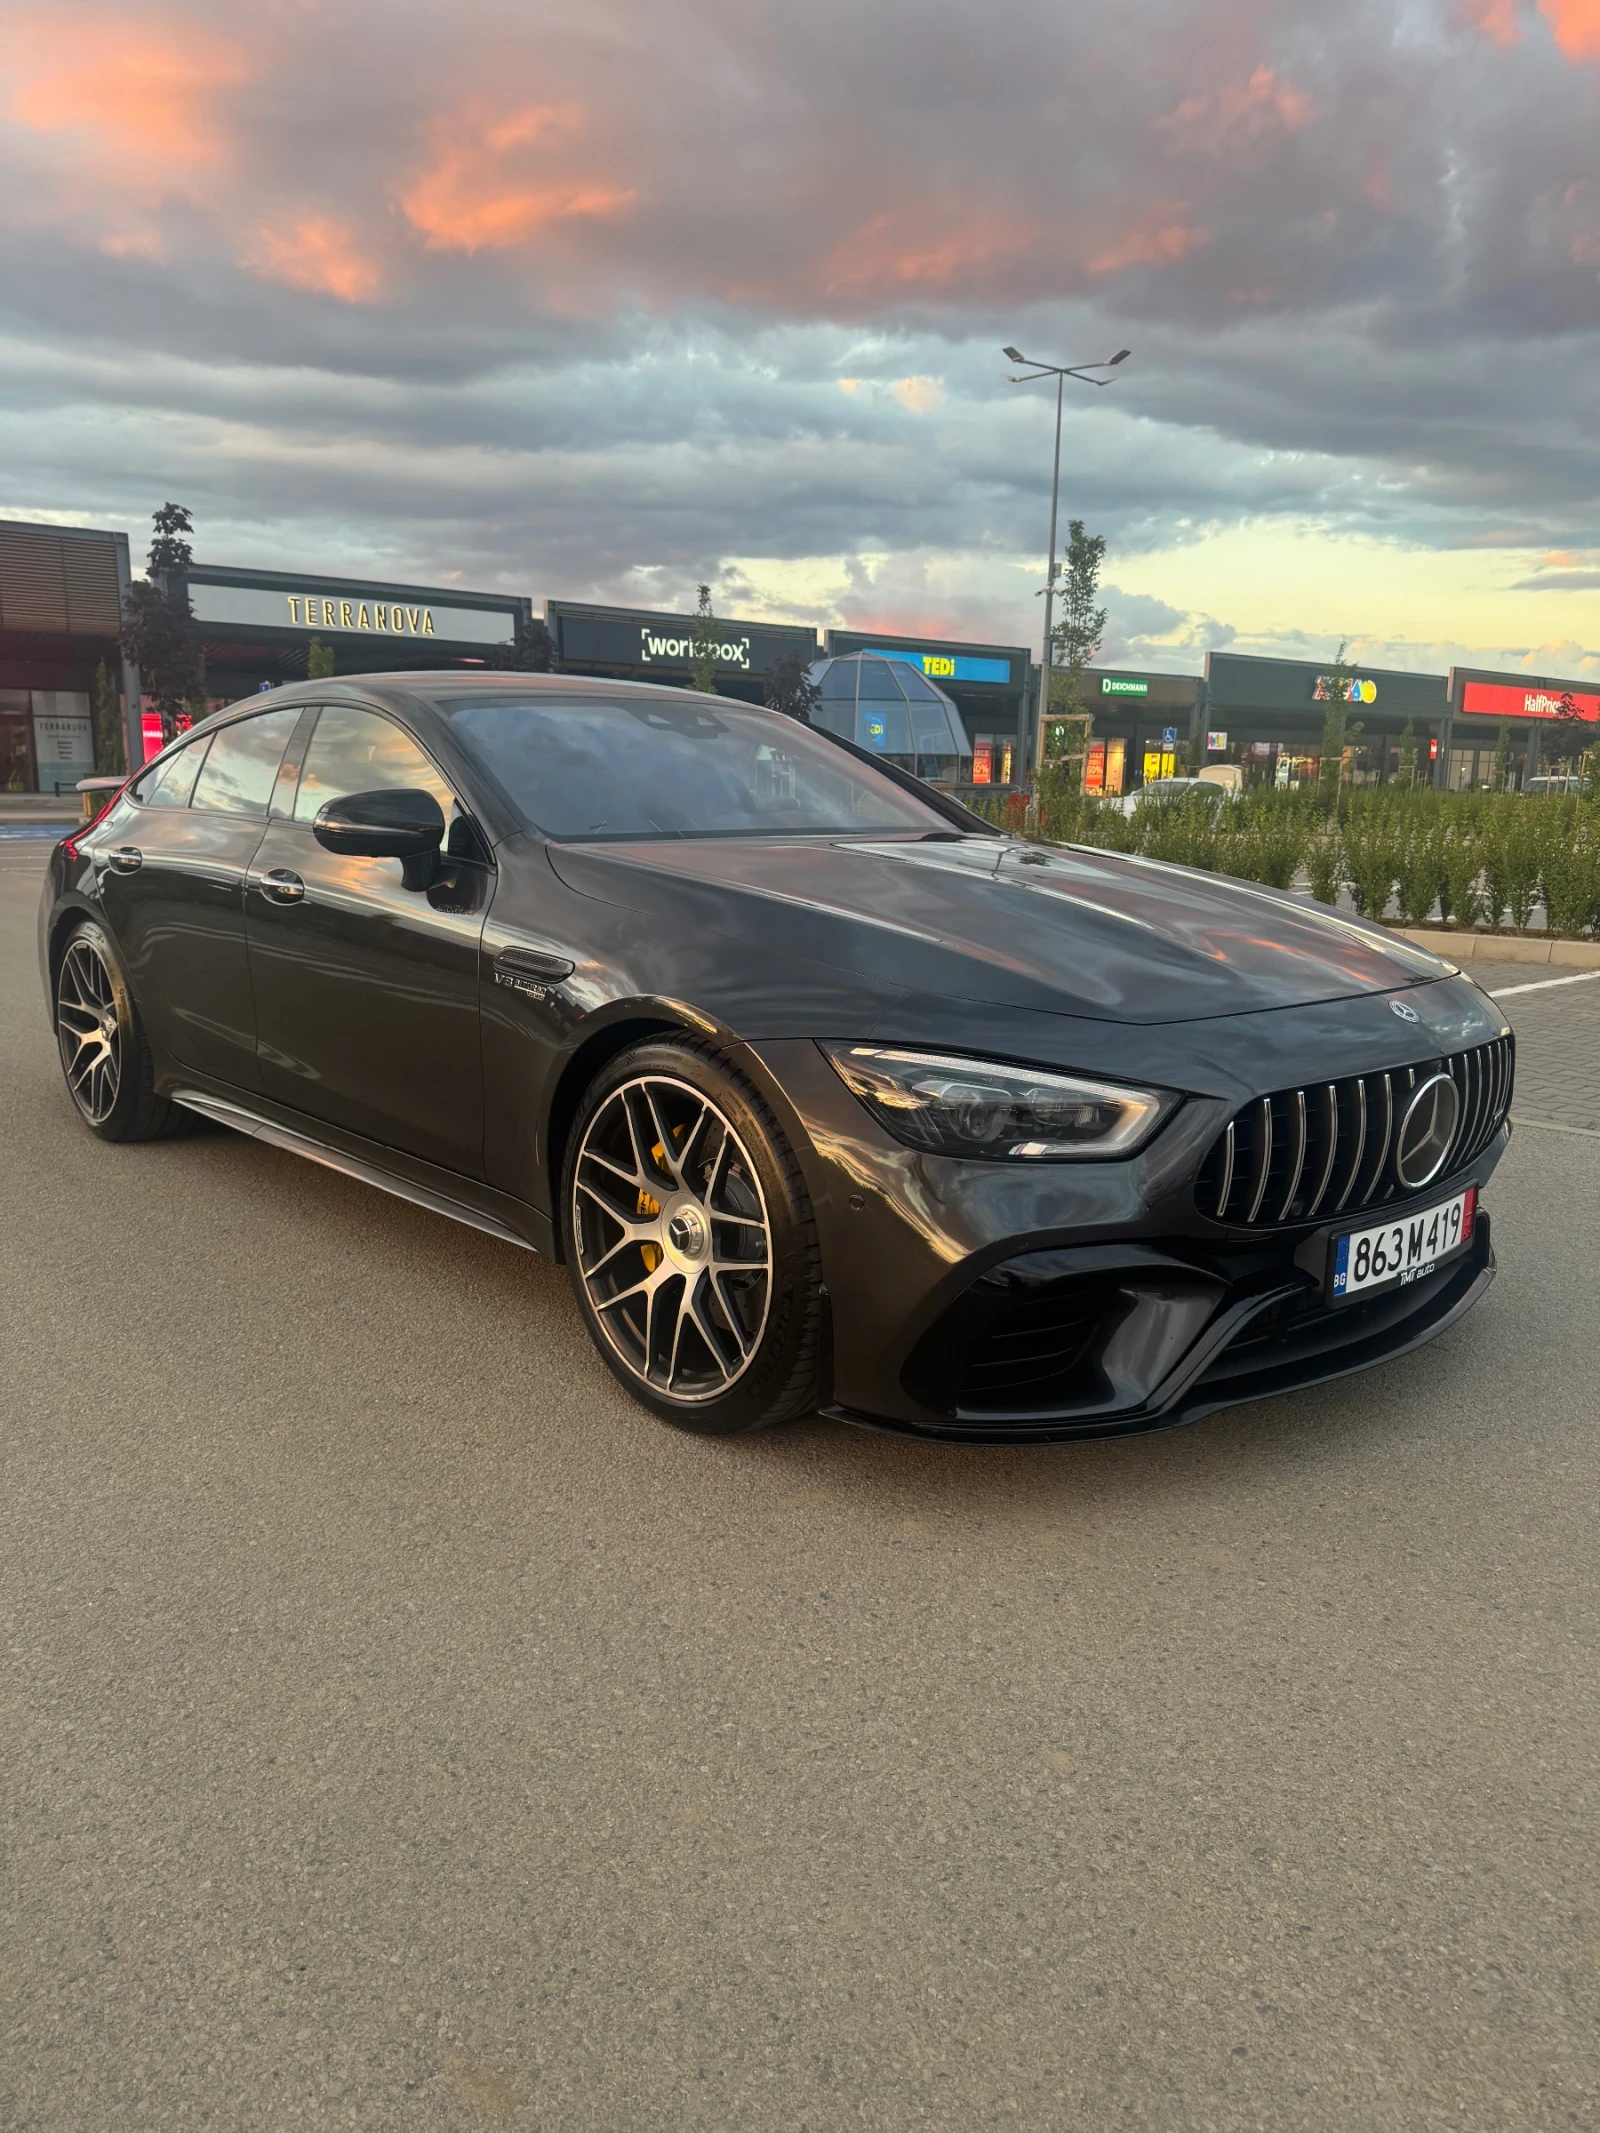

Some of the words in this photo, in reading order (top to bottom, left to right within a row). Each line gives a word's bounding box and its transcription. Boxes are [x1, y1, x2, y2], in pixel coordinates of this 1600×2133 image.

[288, 596, 435, 635] TERRANOVA
[922, 656, 955, 676] TEDi
[1112, 682, 1148, 692] DEICHMANN
[1354, 1203, 1461, 1282] 863M419
[1333, 1272, 1346, 1288] BG
[1416, 1263, 1435, 1279] auto
